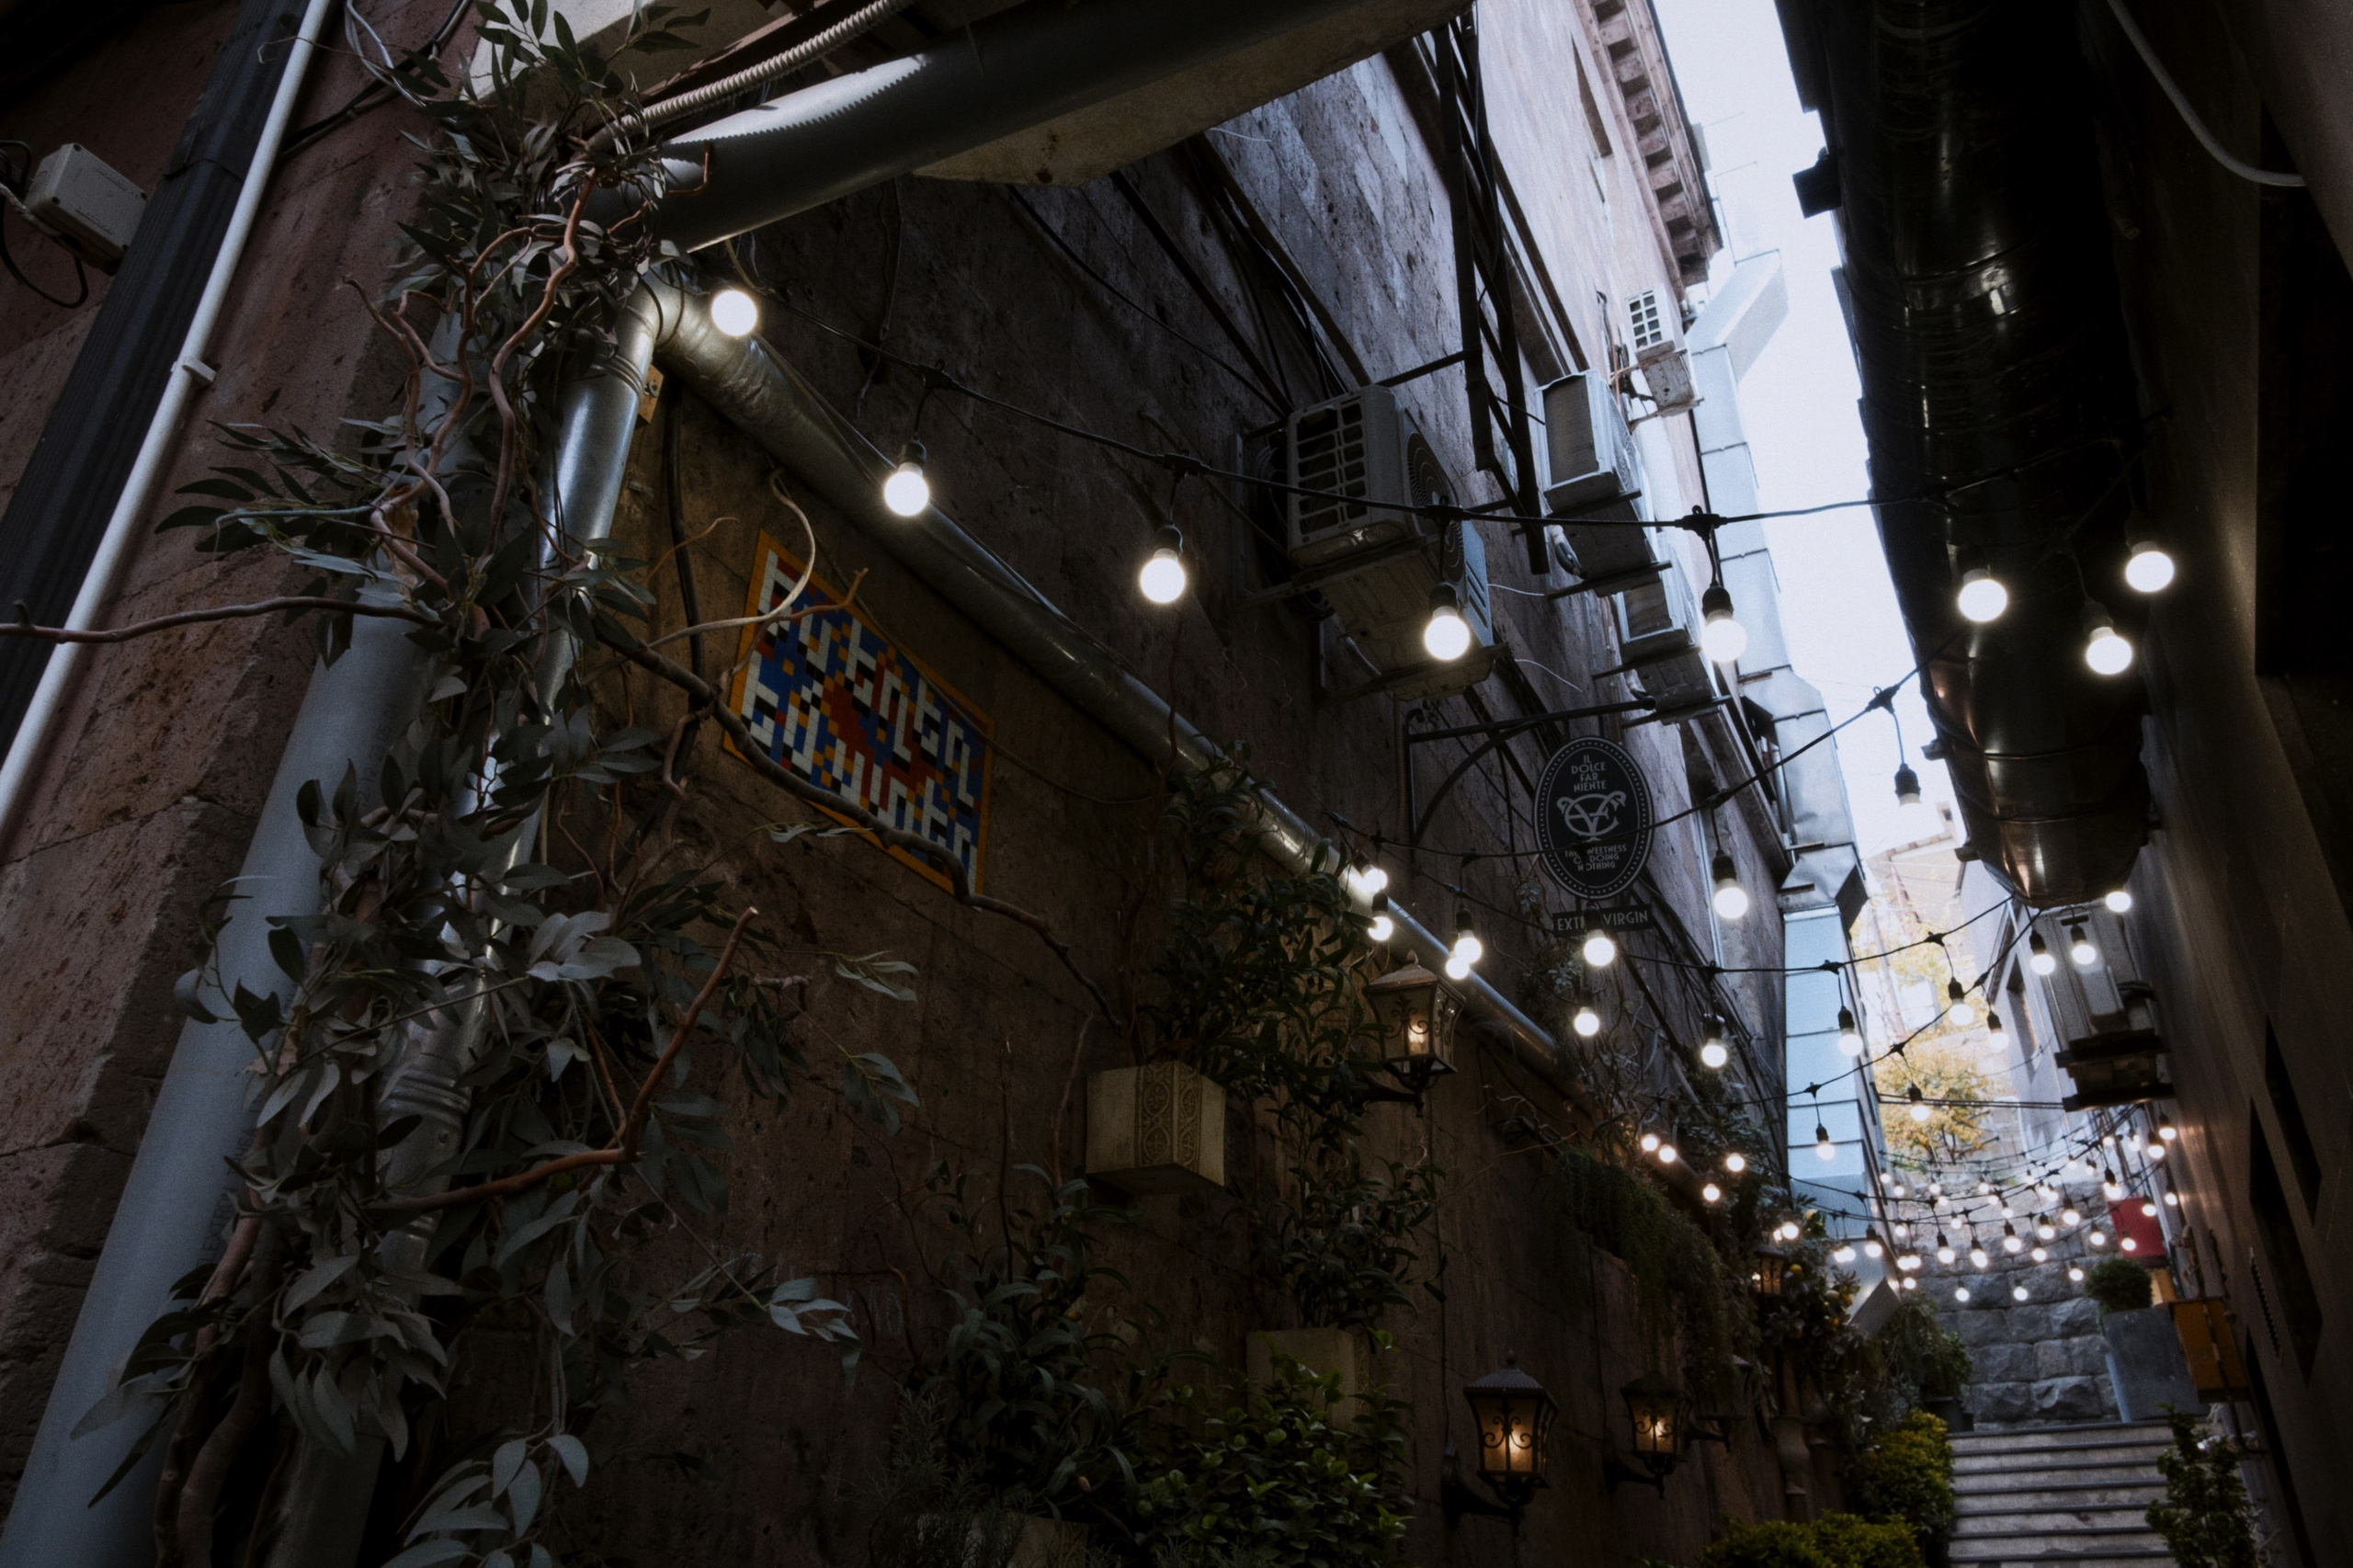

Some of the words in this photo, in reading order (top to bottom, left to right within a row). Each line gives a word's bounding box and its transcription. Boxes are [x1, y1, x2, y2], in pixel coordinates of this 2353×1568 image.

[1583, 755, 1592, 764] IL
[1571, 762, 1607, 774] DOLCE
[1580, 773, 1598, 782] FAR
[1574, 780, 1607, 792] NIENTE
[1585, 844, 1627, 855] WEETNESS
[1589, 852, 1620, 863] DOING
[1602, 910, 1649, 926] VIRGIN
